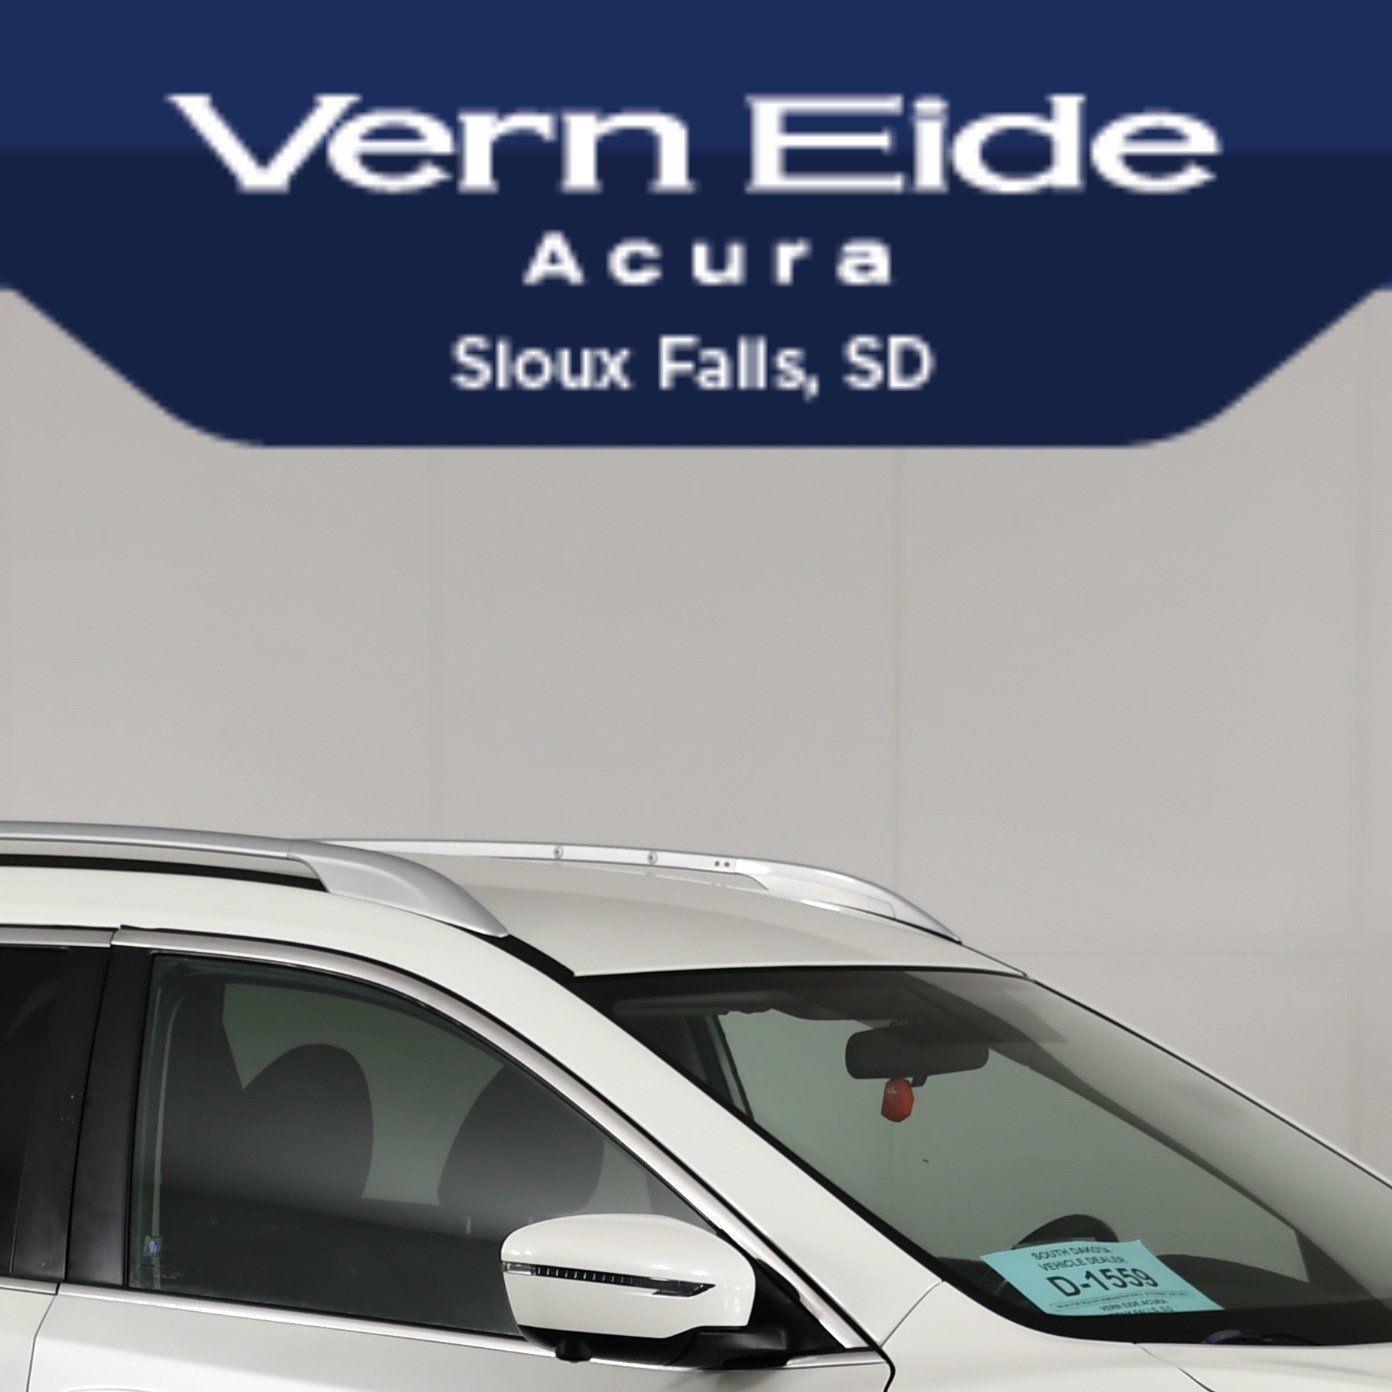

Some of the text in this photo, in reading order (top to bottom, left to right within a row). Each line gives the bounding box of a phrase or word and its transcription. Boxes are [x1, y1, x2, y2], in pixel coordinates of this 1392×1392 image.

[1030, 1245, 1112, 1261] SOUTH DAKOTA
[1038, 1255, 1128, 1272] VEHICLE DEALER
[1046, 1267, 1159, 1297] D-1559
